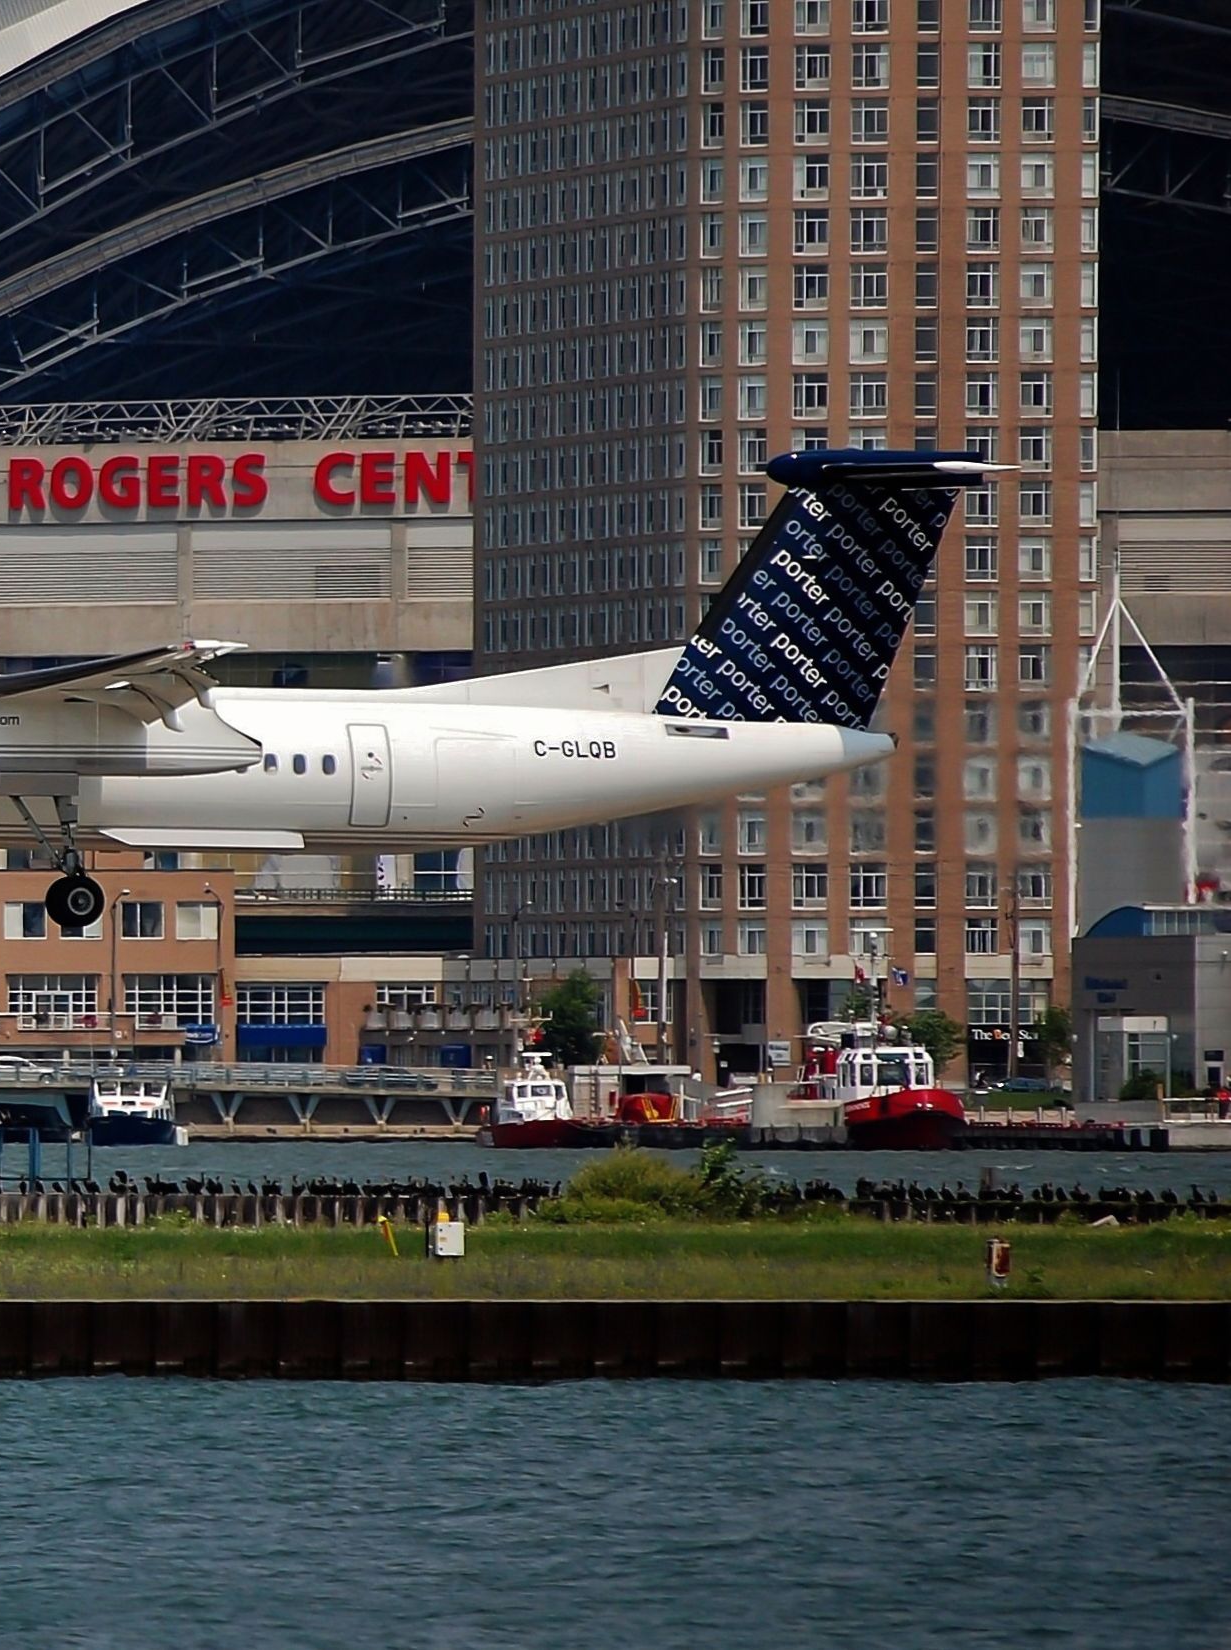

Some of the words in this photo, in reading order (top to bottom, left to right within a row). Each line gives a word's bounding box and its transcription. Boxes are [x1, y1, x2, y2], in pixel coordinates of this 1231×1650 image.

[8, 453, 267, 512] ROGERS
[826, 523, 882, 578] porter
[878, 497, 933, 552] porter
[770, 549, 830, 605] porter
[823, 606, 879, 661] porter
[824, 564, 880, 620] porter
[770, 633, 828, 688] porter
[771, 591, 829, 647] porter
[822, 648, 877, 703] porter
[715, 659, 775, 715] porter
[534, 739, 616, 759] C-GLQB
[971, 1029, 993, 1040] The
